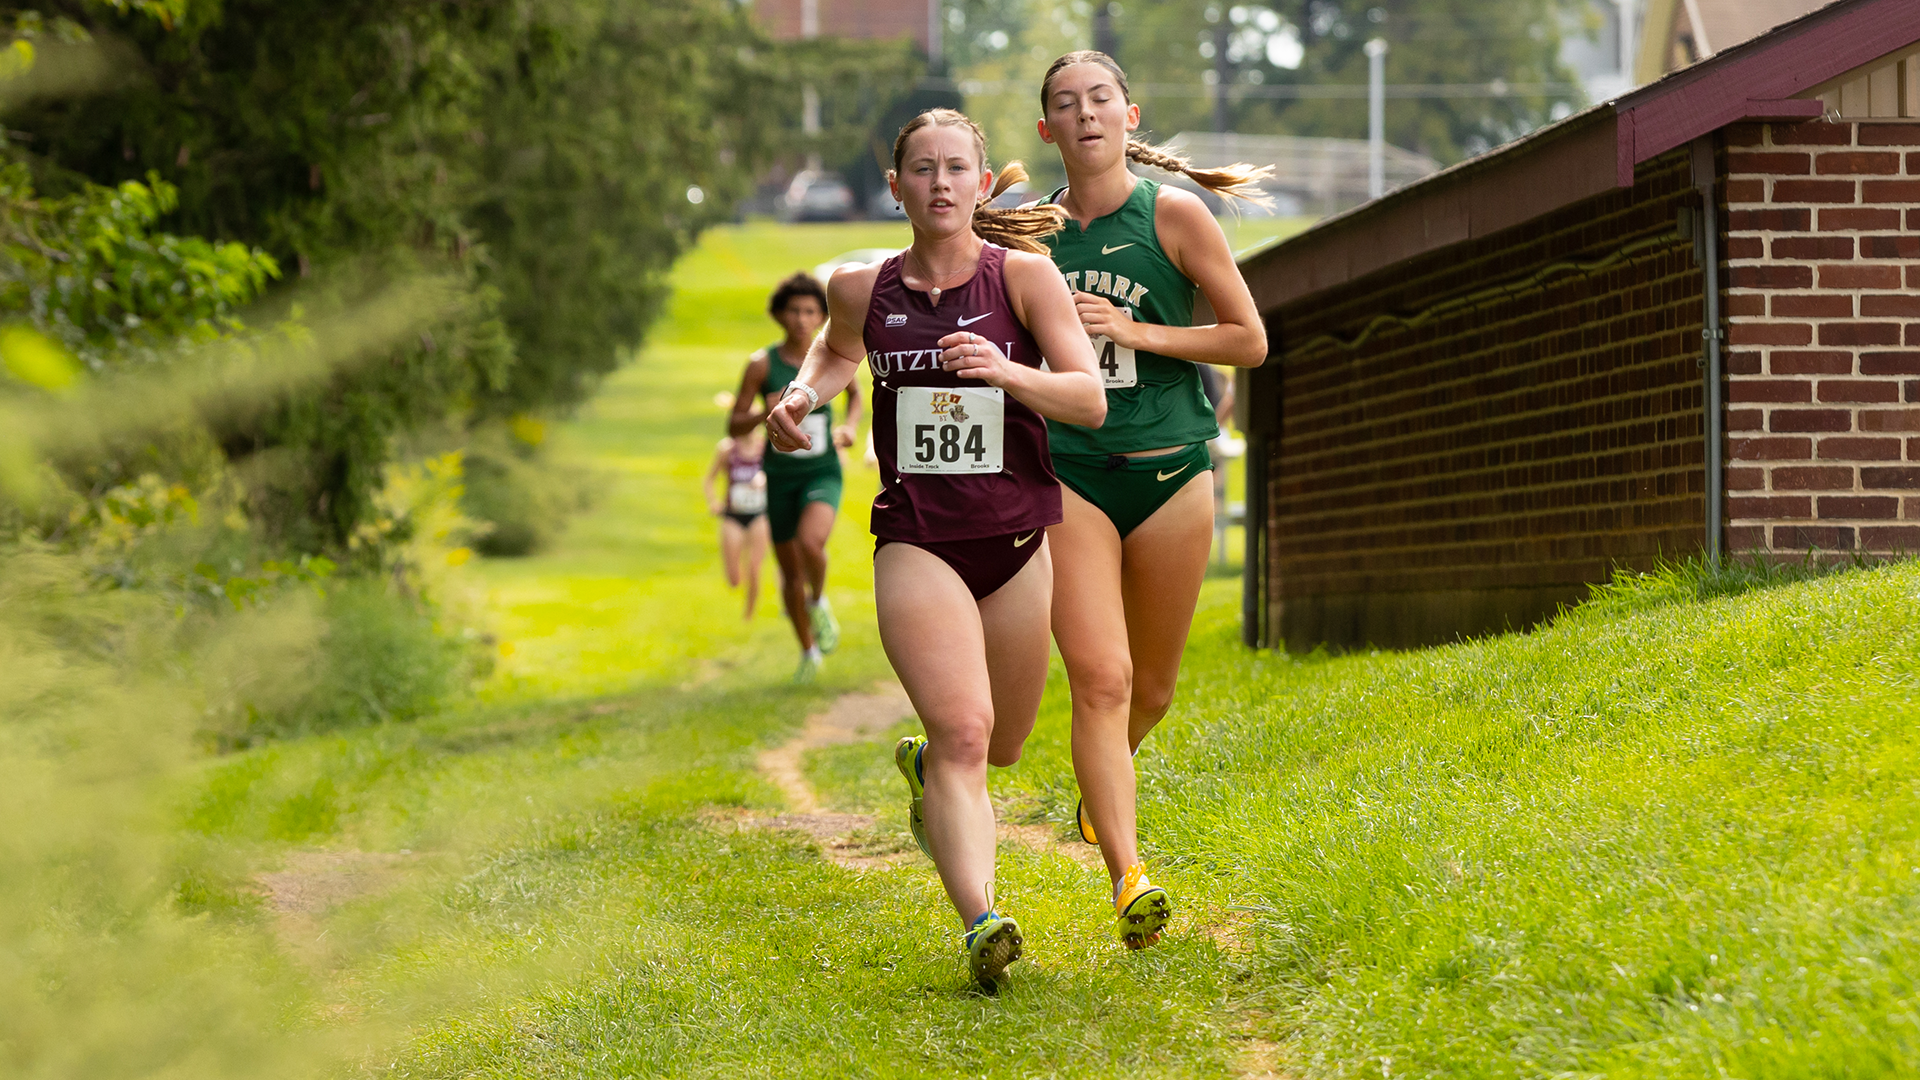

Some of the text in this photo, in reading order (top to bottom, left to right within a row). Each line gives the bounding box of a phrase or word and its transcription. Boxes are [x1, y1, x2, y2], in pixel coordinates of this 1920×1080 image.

[1085, 270, 1149, 307] PARK
[868, 341, 1012, 378] KUTZTN
[931, 403, 949, 414] XC
[915, 424, 986, 462] 584
